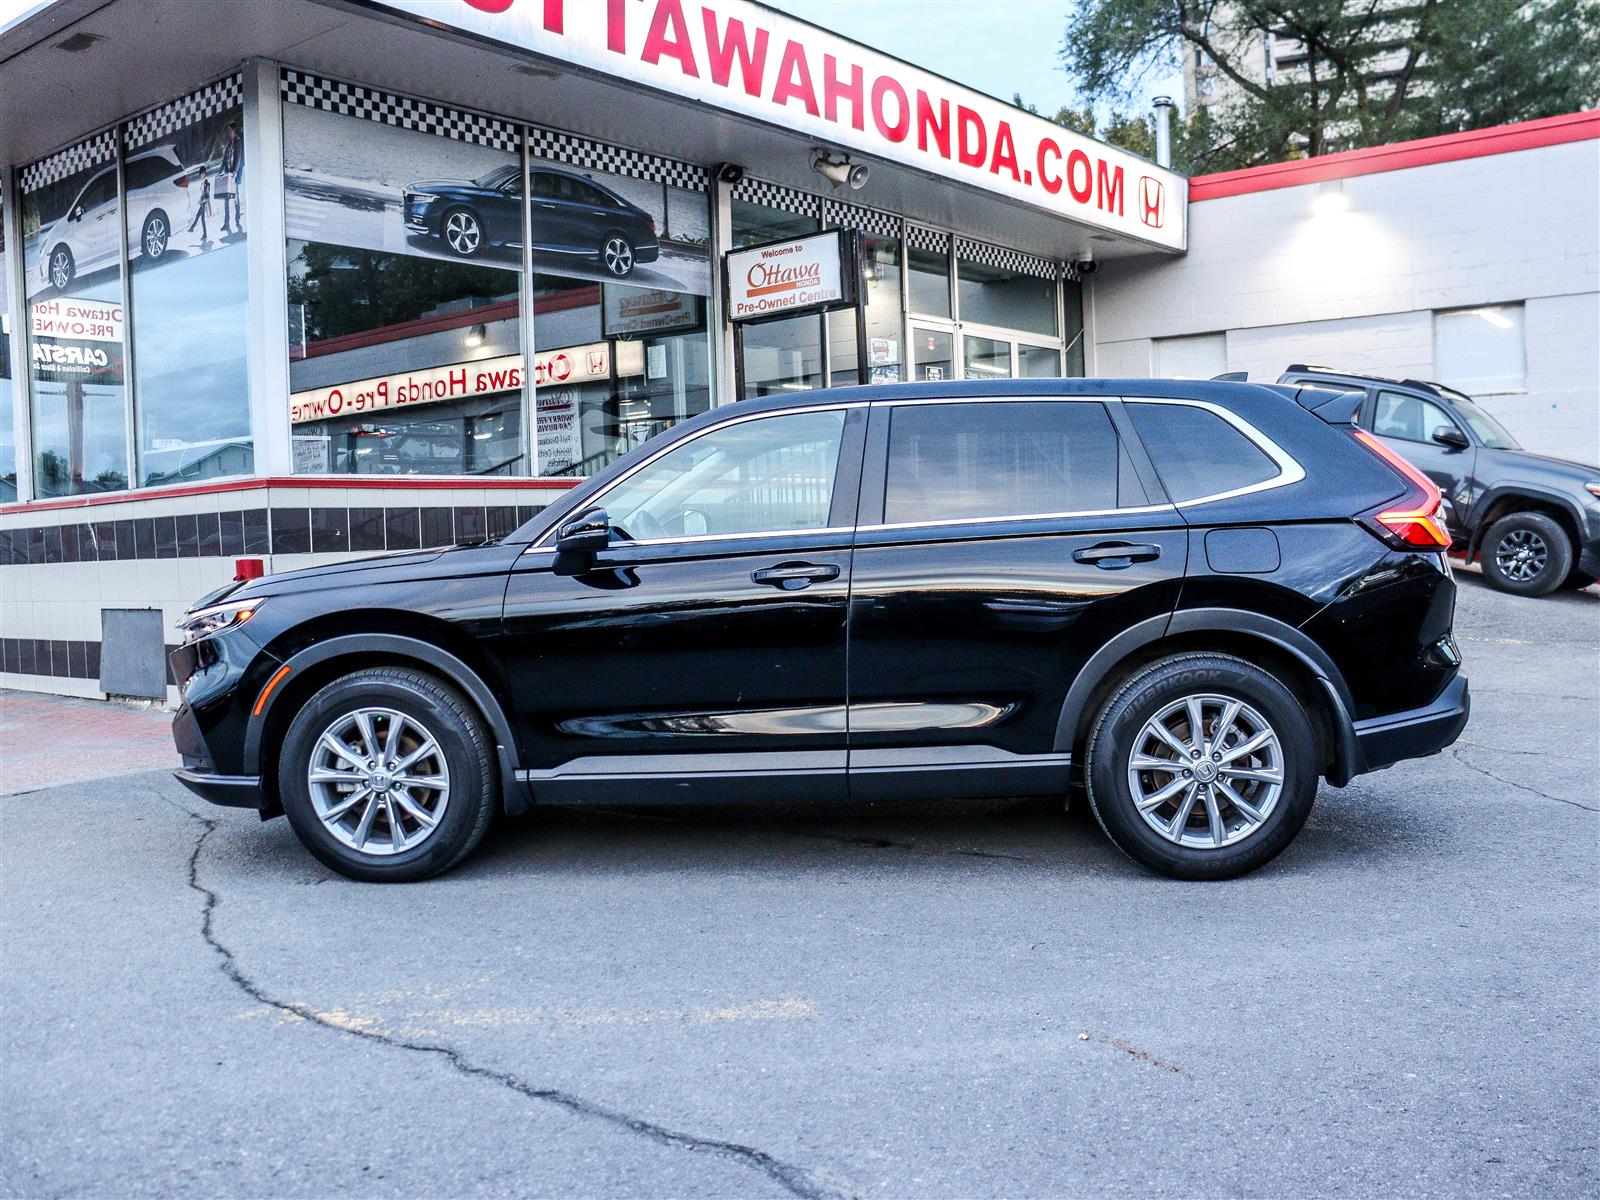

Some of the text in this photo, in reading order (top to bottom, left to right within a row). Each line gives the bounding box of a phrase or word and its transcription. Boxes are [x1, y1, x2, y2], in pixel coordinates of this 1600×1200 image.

[462, 0, 1124, 217] TAWAHONDA.COM
[761, 244, 803, 259] Welcome to
[747, 262, 820, 287] Ottawa
[796, 278, 820, 288] HONDA
[737, 288, 836, 314] Pre-Owned Centre
